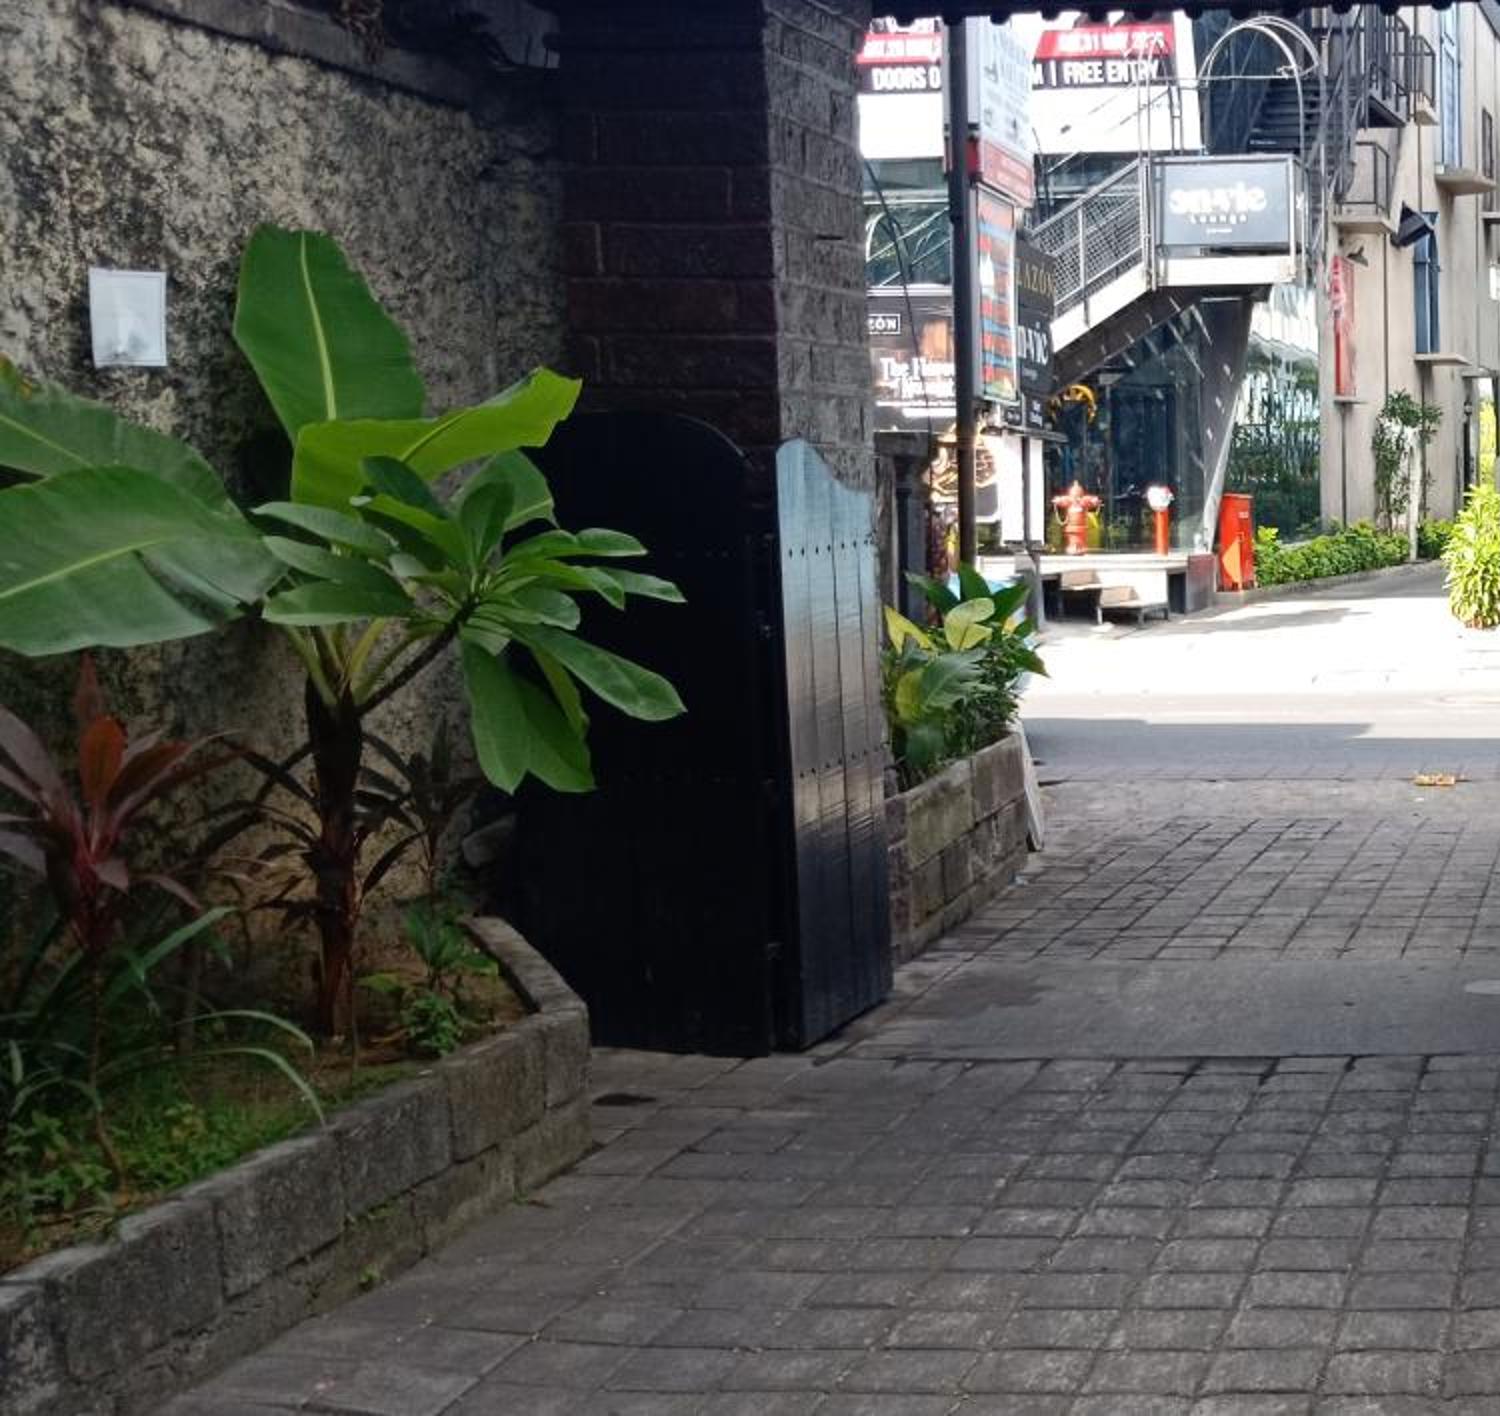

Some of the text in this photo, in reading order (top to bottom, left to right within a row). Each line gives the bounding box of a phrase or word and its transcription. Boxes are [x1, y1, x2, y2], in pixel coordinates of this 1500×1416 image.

[871, 65, 927, 91] DOORS
[1062, 61, 1104, 84] FREE
[1105, 60, 1159, 83] ENTRY
